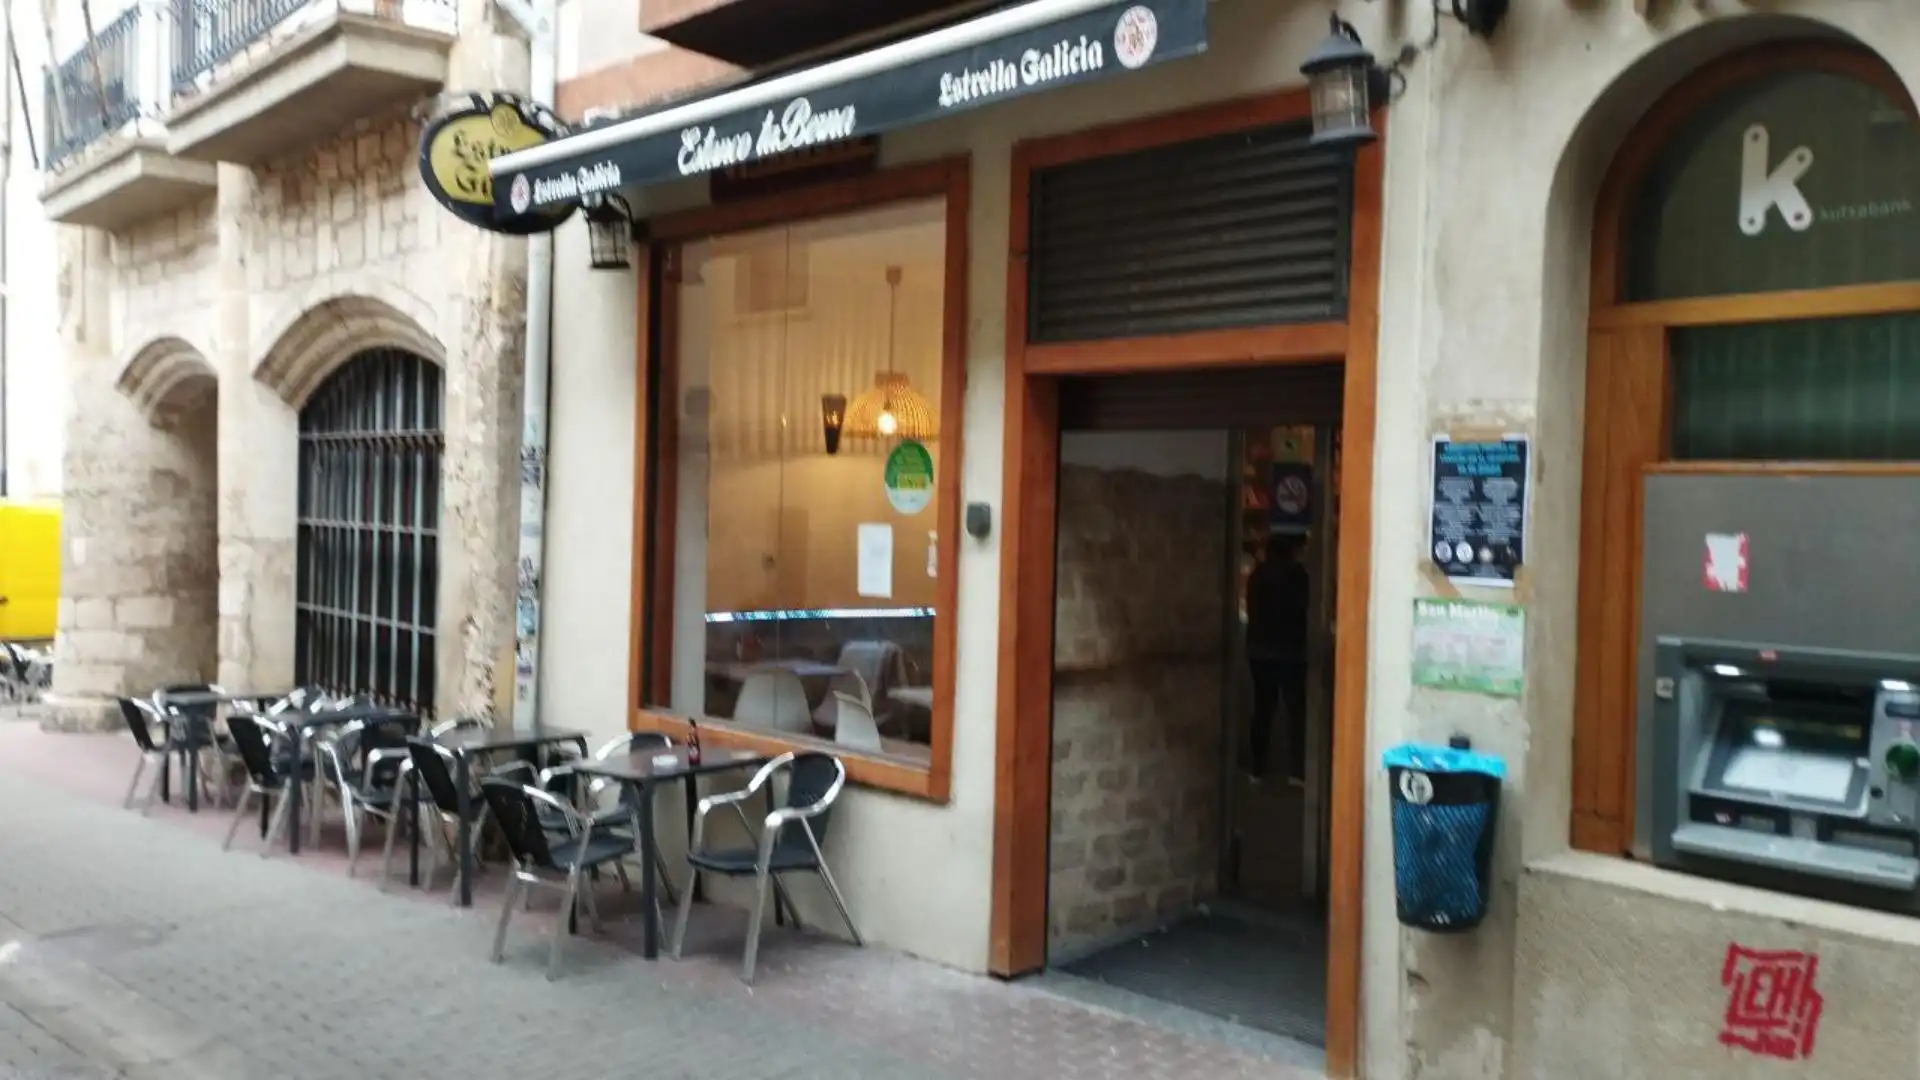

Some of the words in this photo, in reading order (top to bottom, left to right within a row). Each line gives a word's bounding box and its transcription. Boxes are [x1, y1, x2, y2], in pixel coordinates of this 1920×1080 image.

[938, 58, 1017, 107] Estrella
[1020, 35, 1104, 85] Galicia
[576, 160, 621, 195] Galicia
